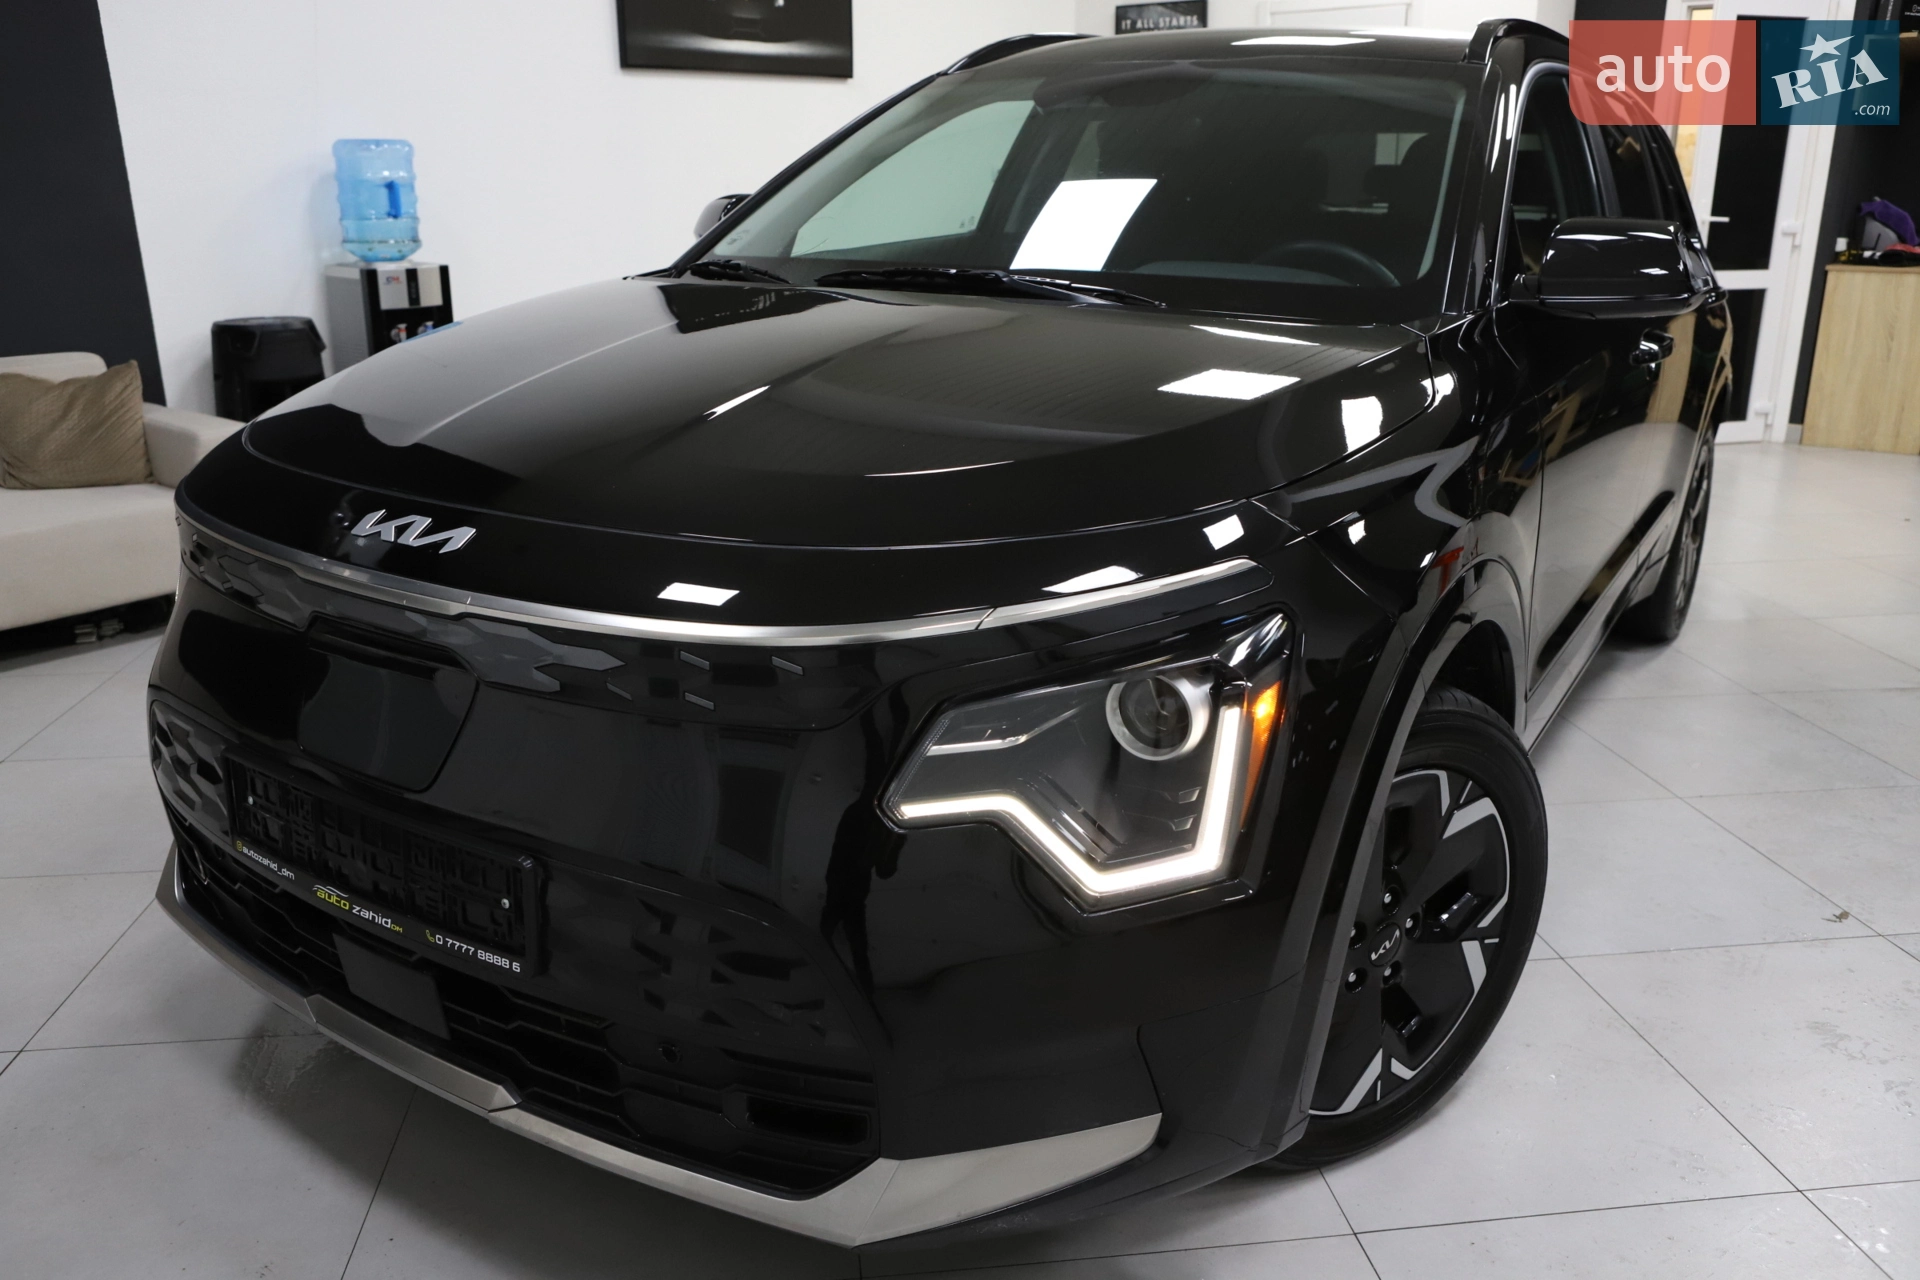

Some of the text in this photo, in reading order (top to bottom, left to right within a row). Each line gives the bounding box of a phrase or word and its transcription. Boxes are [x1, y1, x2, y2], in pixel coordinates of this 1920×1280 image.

[1122, 15, 1198, 31] IT ALL STARTS
[242, 846, 295, 880] autozahid_dm
[316, 889, 350, 910] auto
